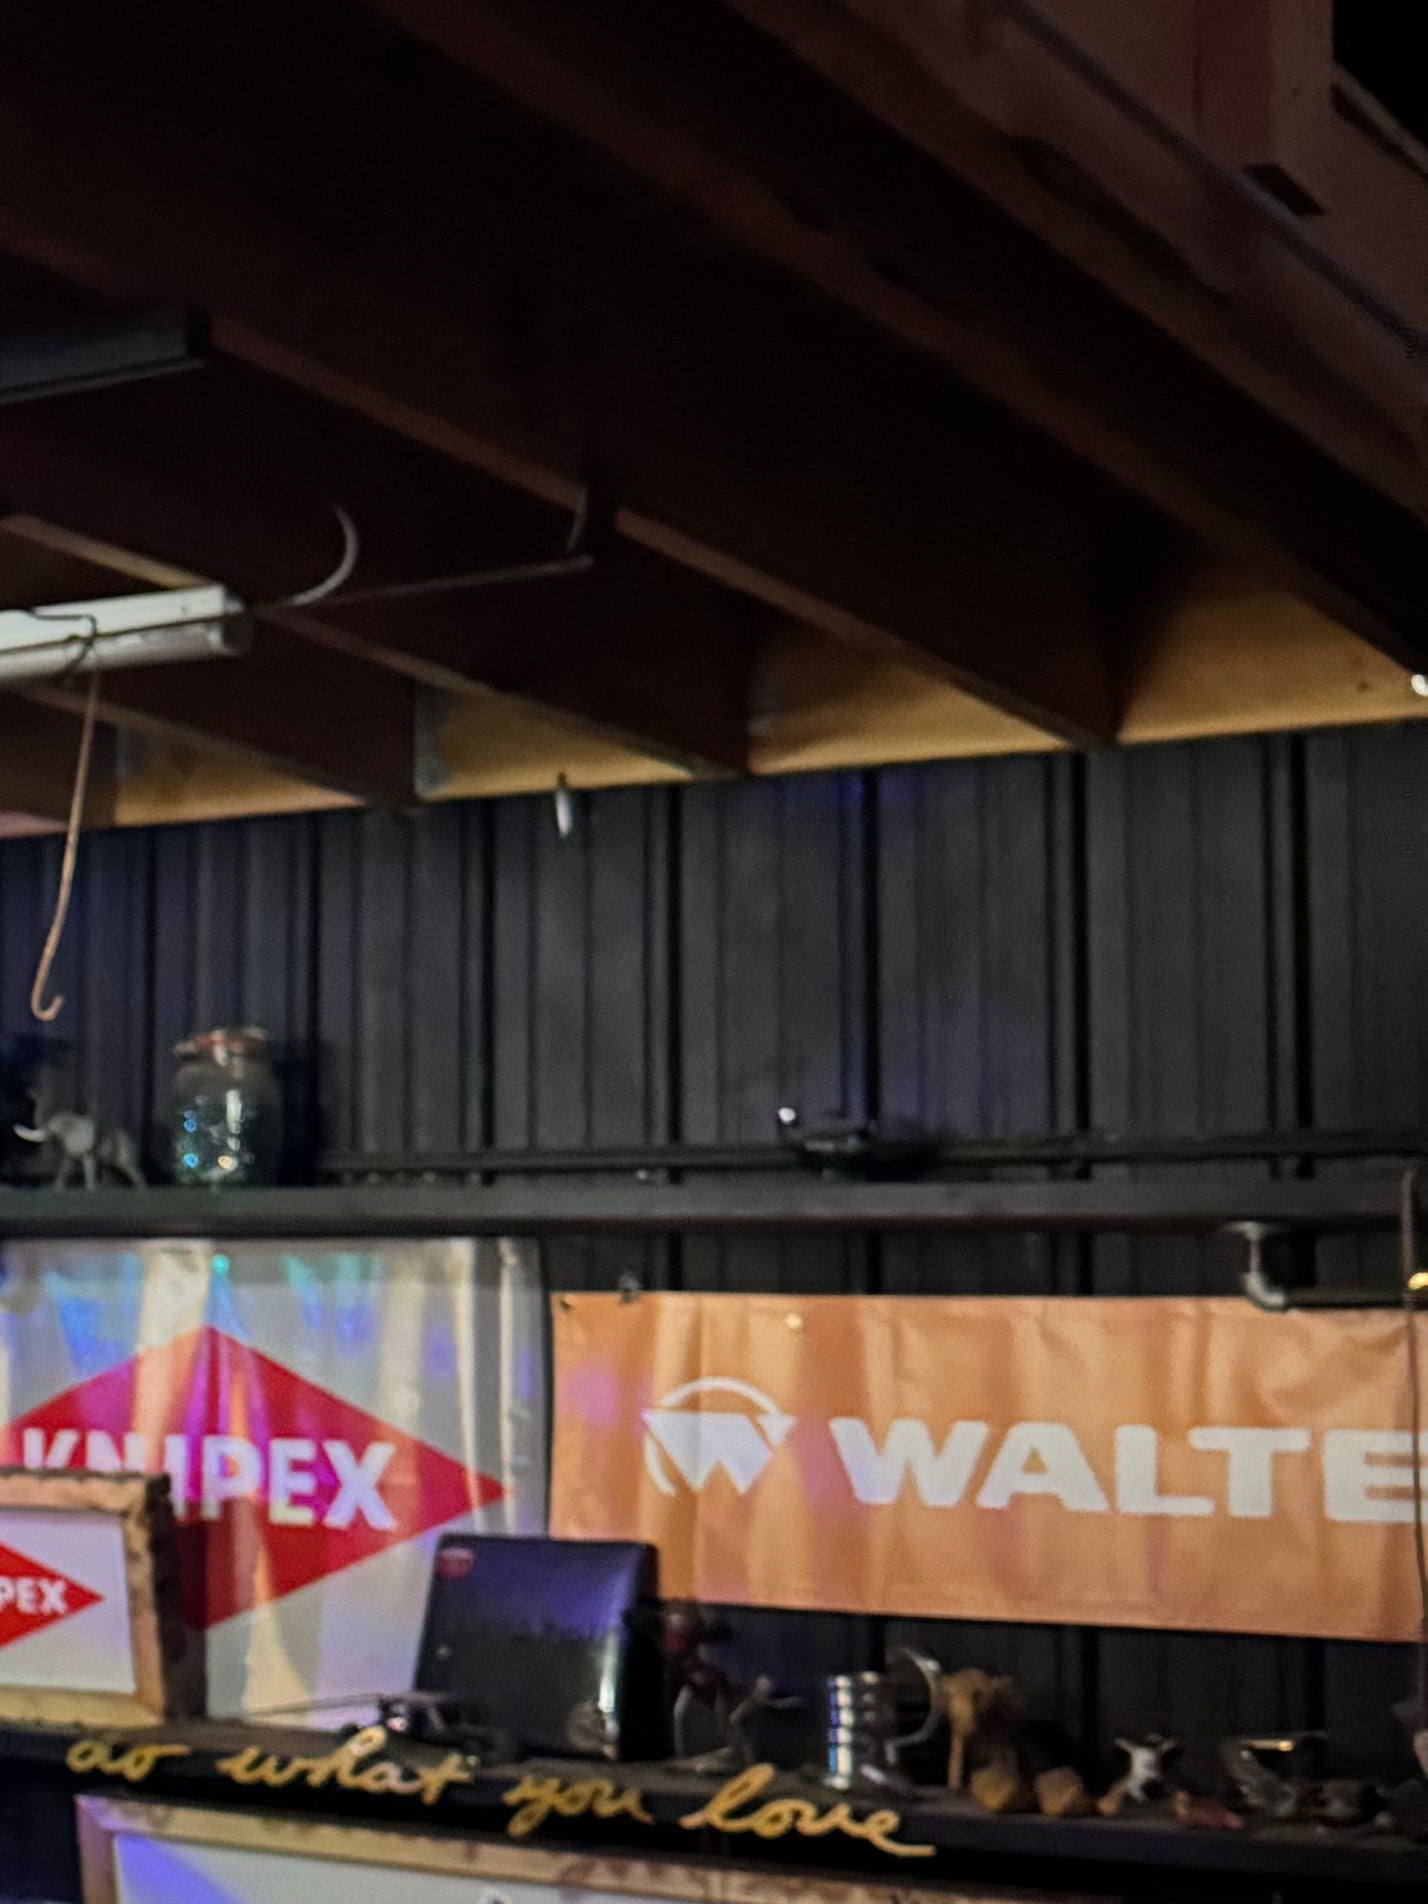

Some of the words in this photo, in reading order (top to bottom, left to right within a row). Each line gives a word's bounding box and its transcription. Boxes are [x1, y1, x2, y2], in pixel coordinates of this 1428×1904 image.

[828, 1416, 1428, 1524] WALTE
[215, 1725, 472, 1805] what
[502, 1775, 654, 1837] you
[678, 1762, 937, 1857] love
